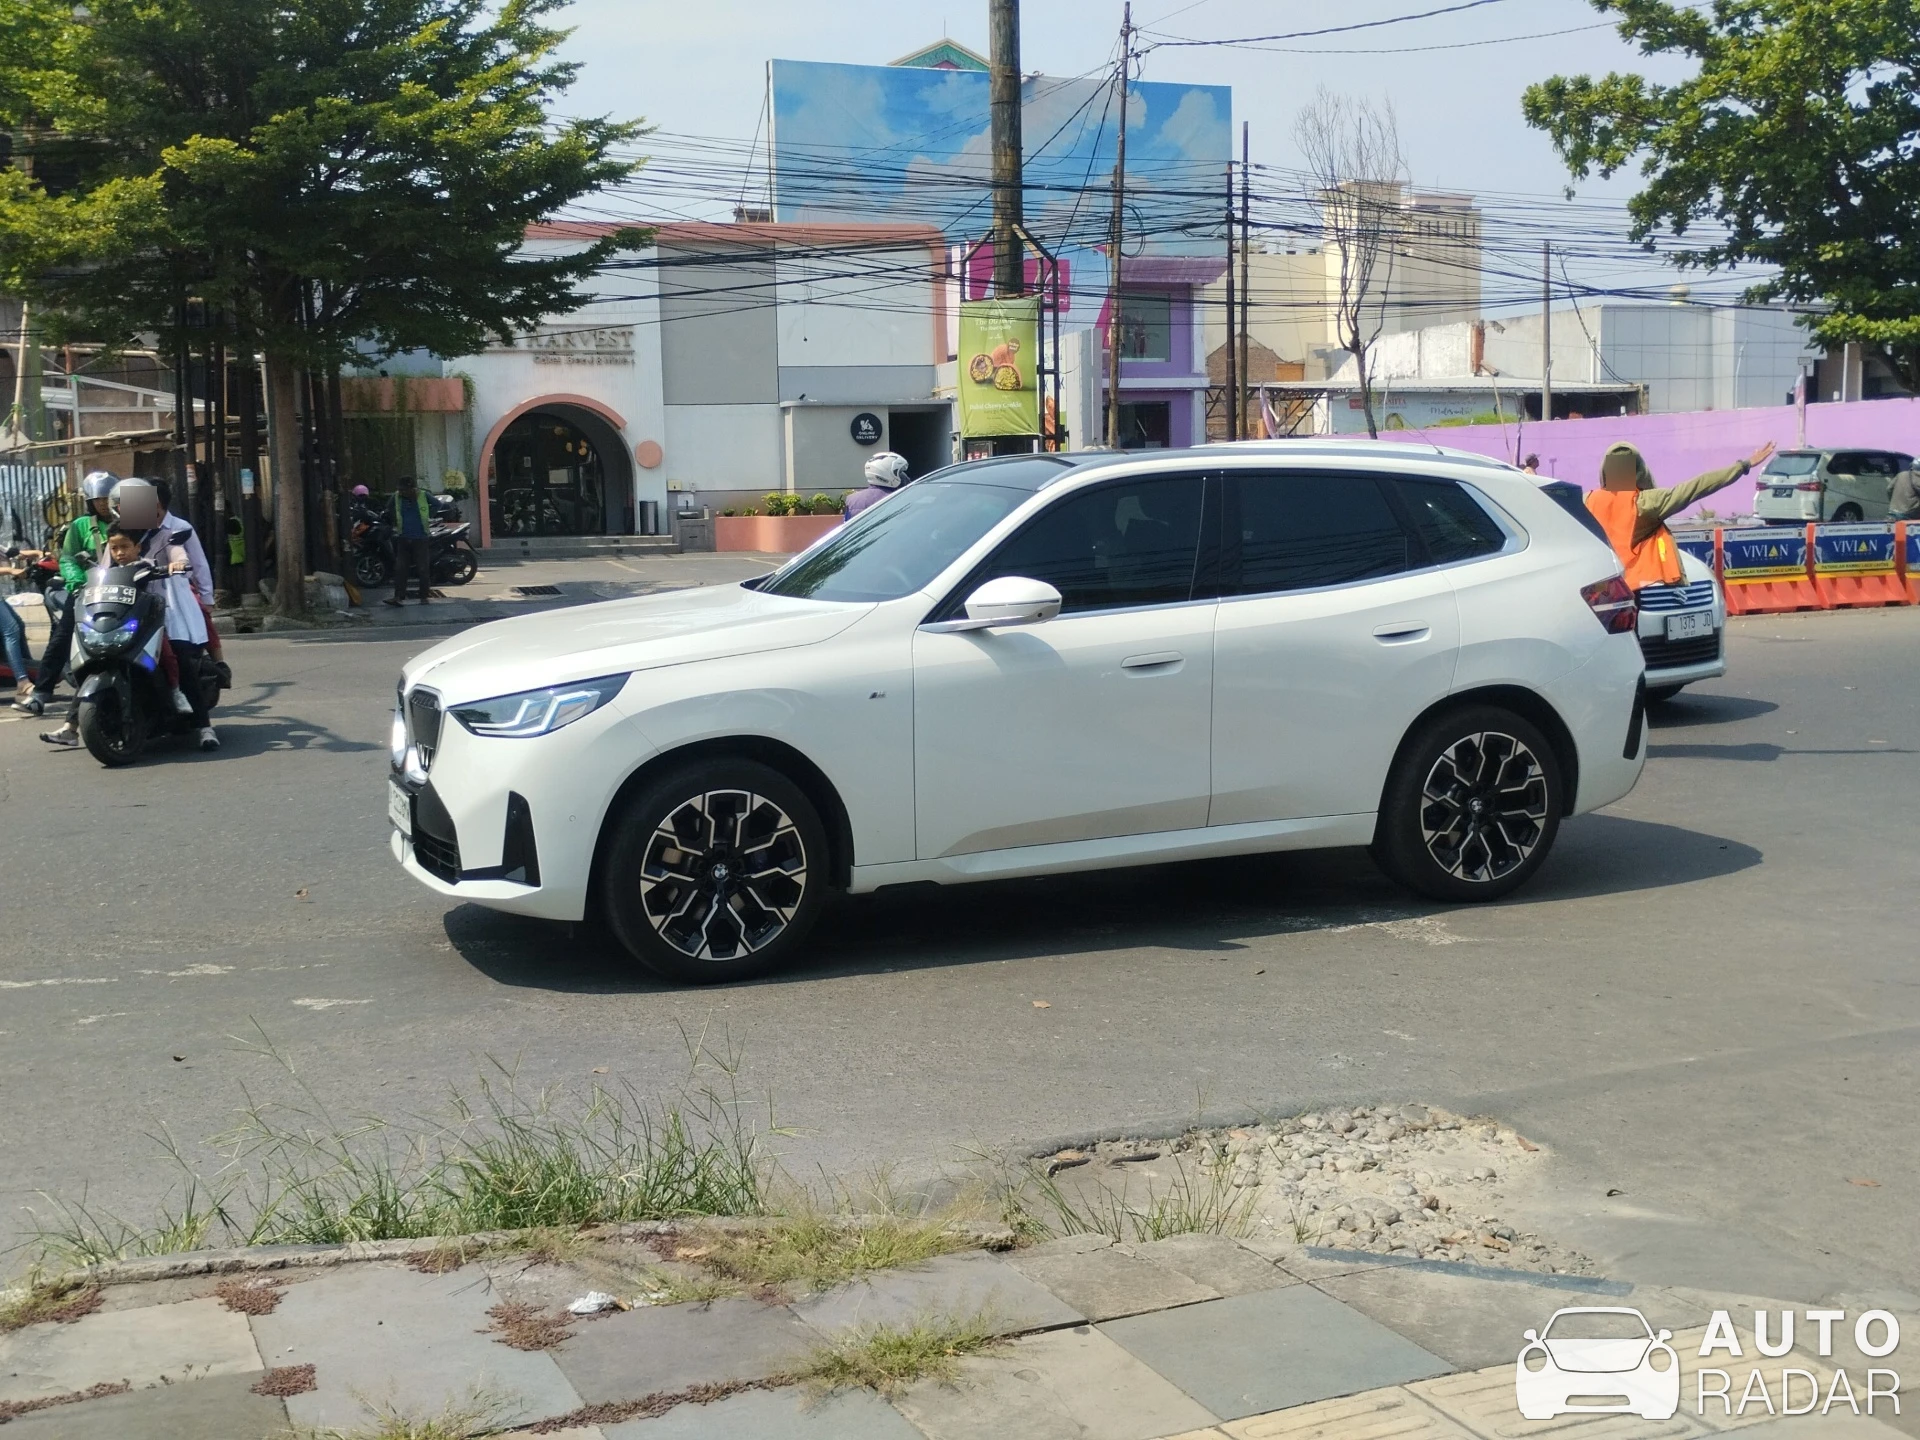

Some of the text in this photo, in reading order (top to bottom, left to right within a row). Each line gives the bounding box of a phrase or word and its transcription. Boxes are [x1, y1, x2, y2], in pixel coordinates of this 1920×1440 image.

[526, 330, 634, 348] HARVEST
[123, 588, 134, 596] CE
[1680, 614, 1695, 630] 1375
